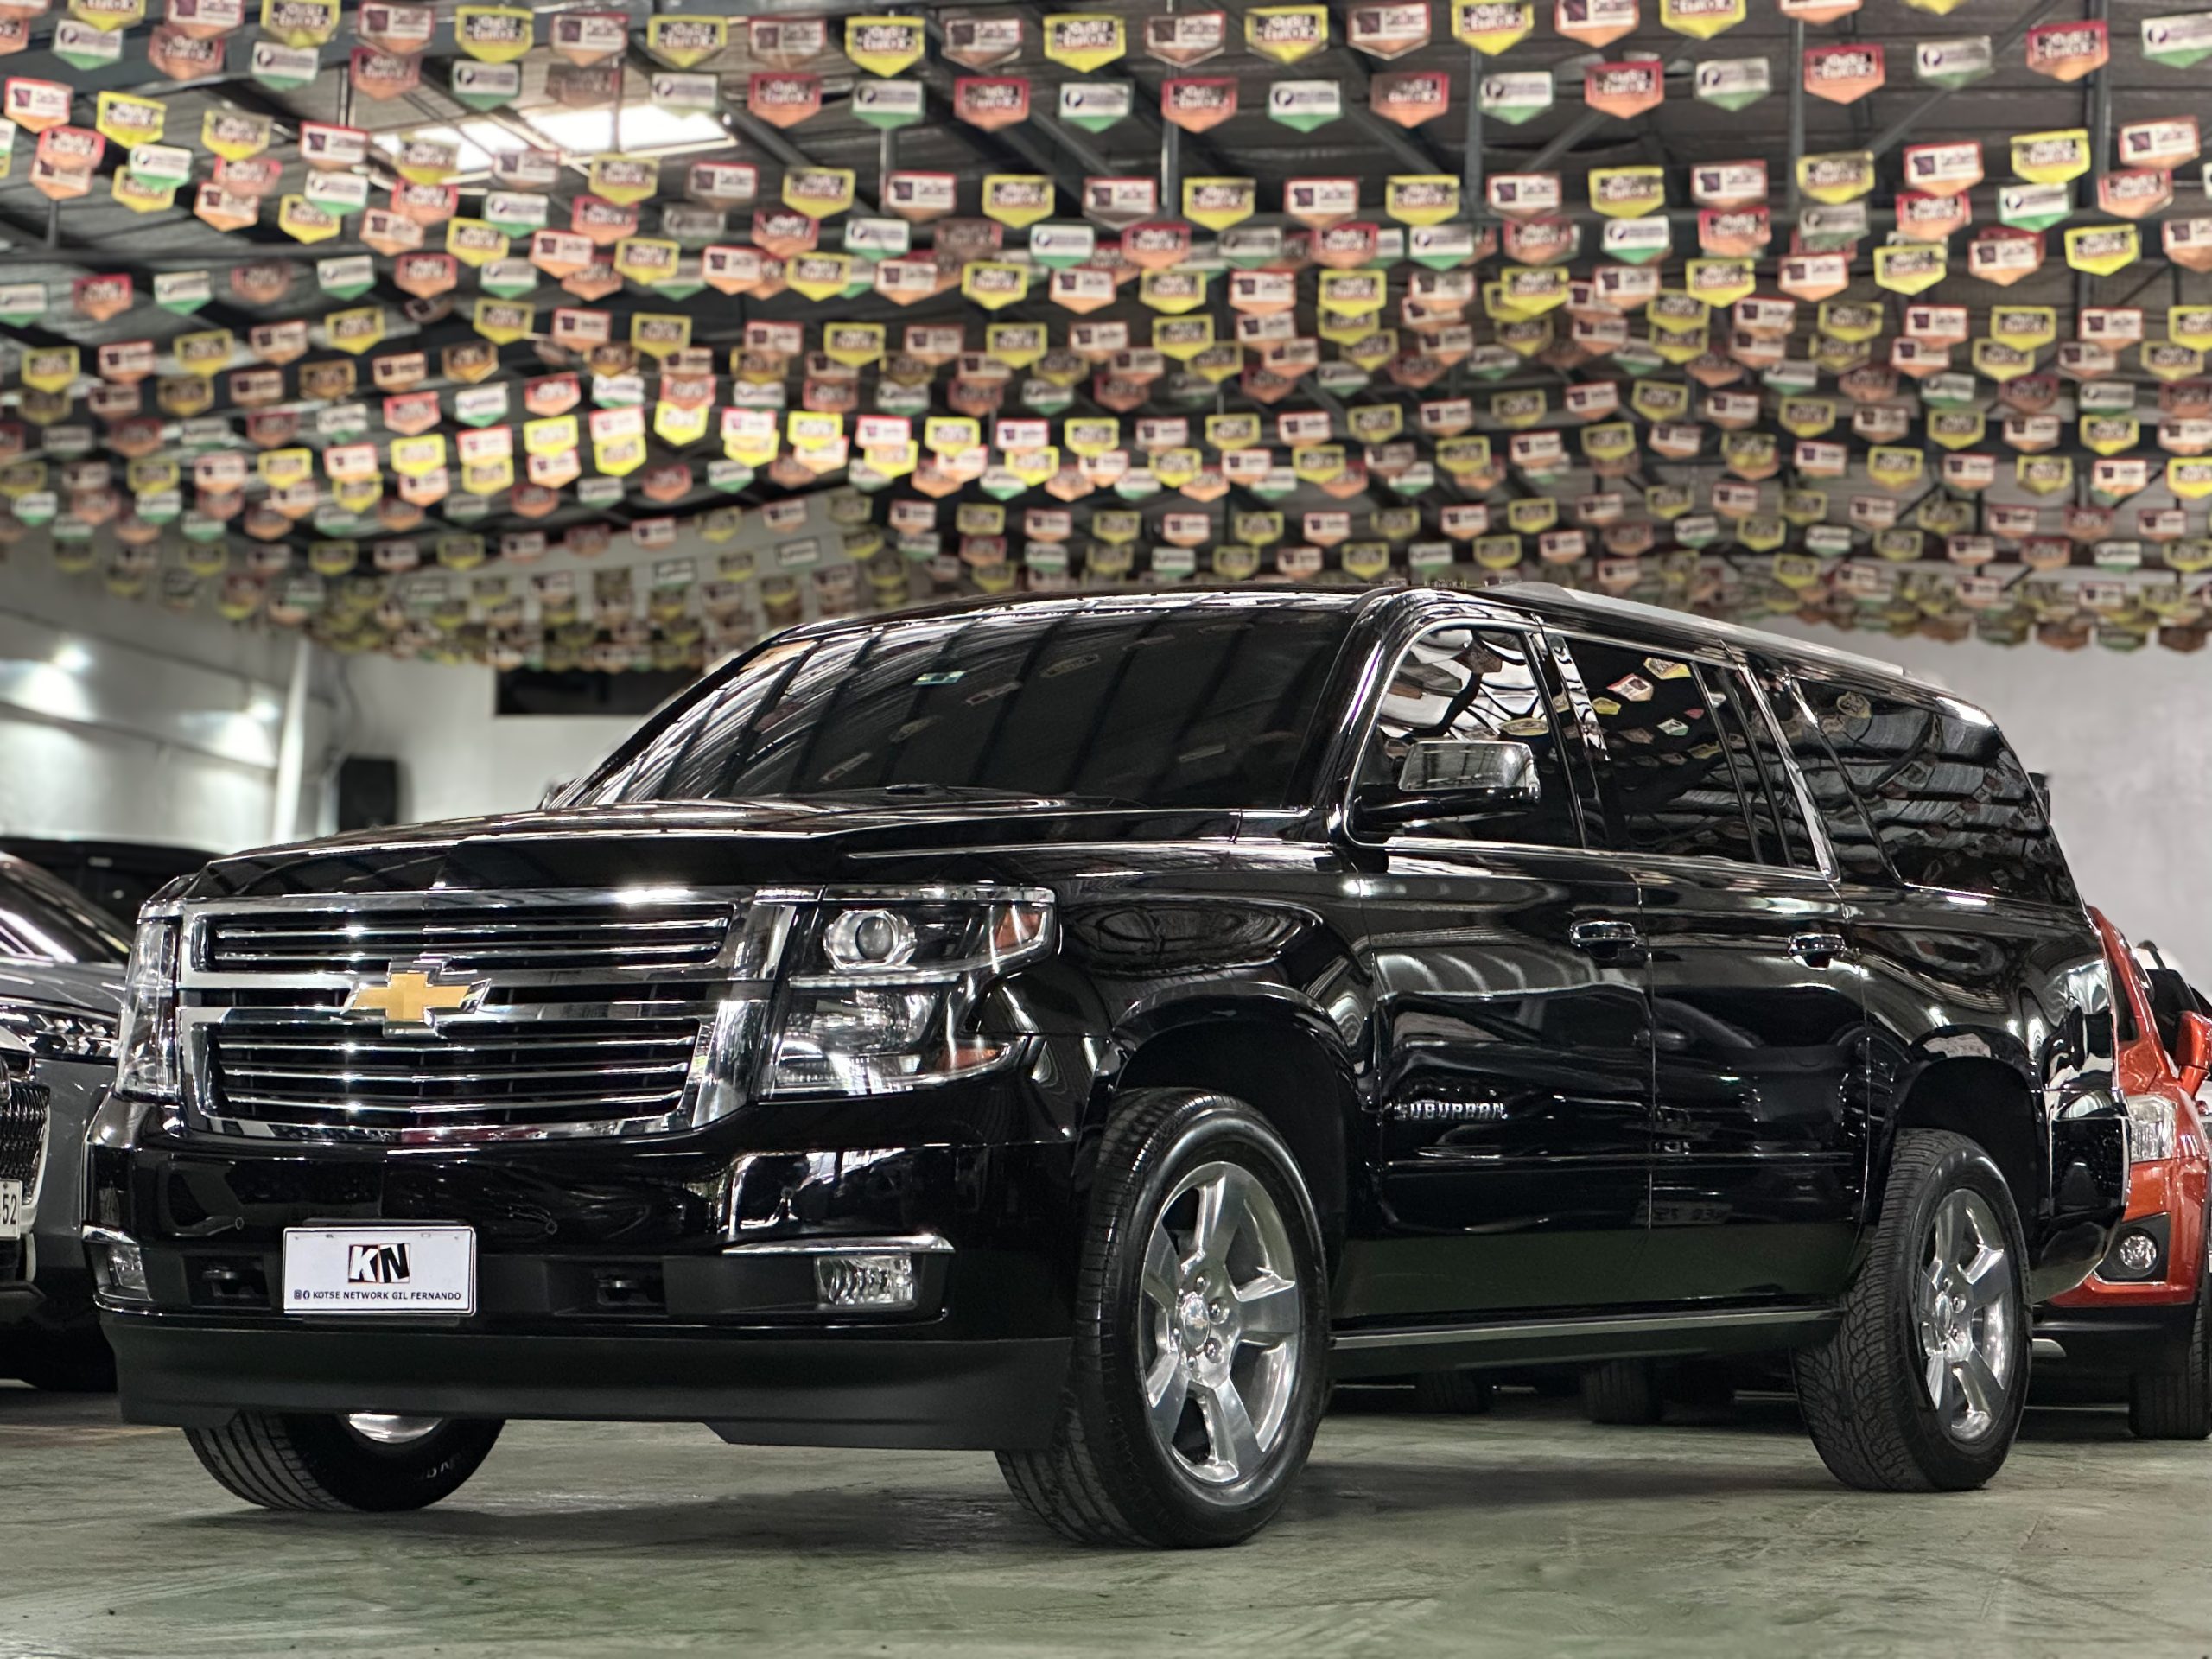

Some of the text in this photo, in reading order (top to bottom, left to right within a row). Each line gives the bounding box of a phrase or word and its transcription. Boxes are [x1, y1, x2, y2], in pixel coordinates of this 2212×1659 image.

[1394, 1102, 1505, 1121] SUBURBAN
[348, 1243, 410, 1284] KN
[313, 1290, 461, 1301] KOTSE NETWORK GIL FERNANDO
